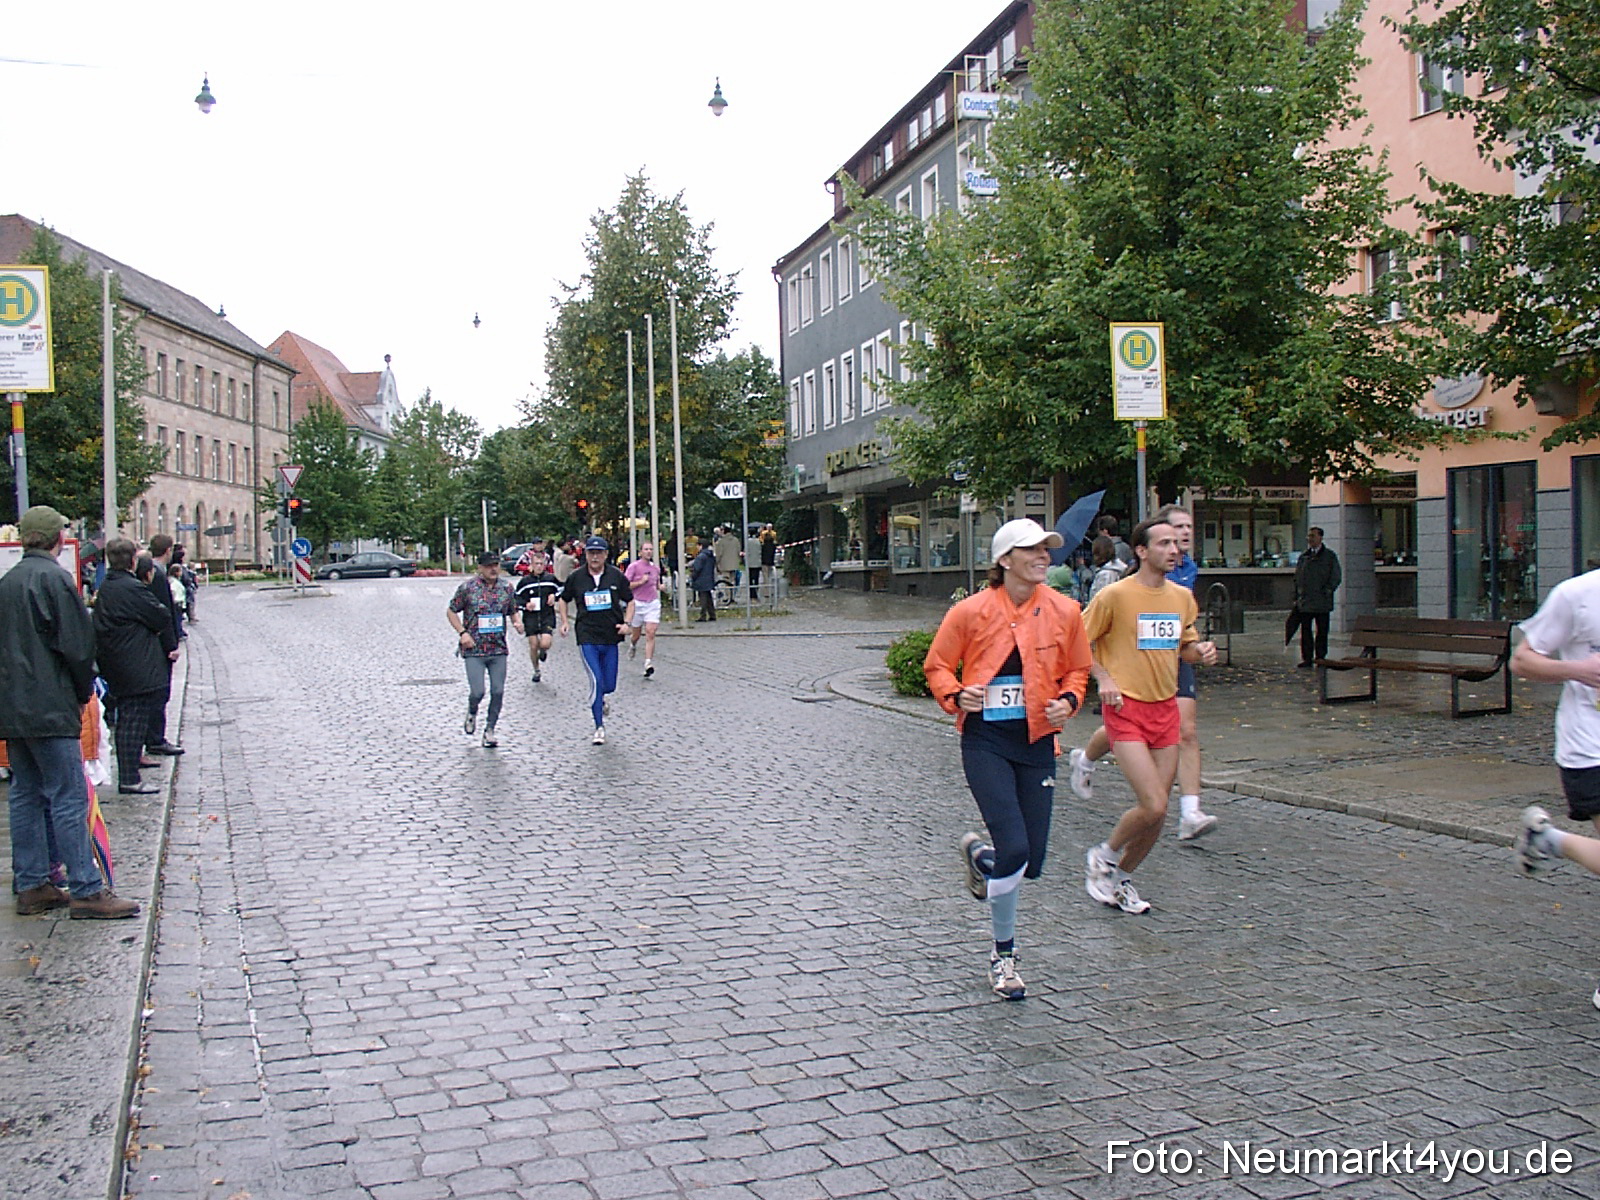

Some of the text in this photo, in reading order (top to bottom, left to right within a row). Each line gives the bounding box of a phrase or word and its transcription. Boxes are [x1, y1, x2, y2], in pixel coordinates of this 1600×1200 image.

[1129, 339, 1147, 361] H
[722, 484, 740, 497] WC
[1151, 621, 1175, 638] 163
[1001, 687, 1025, 706] 57
